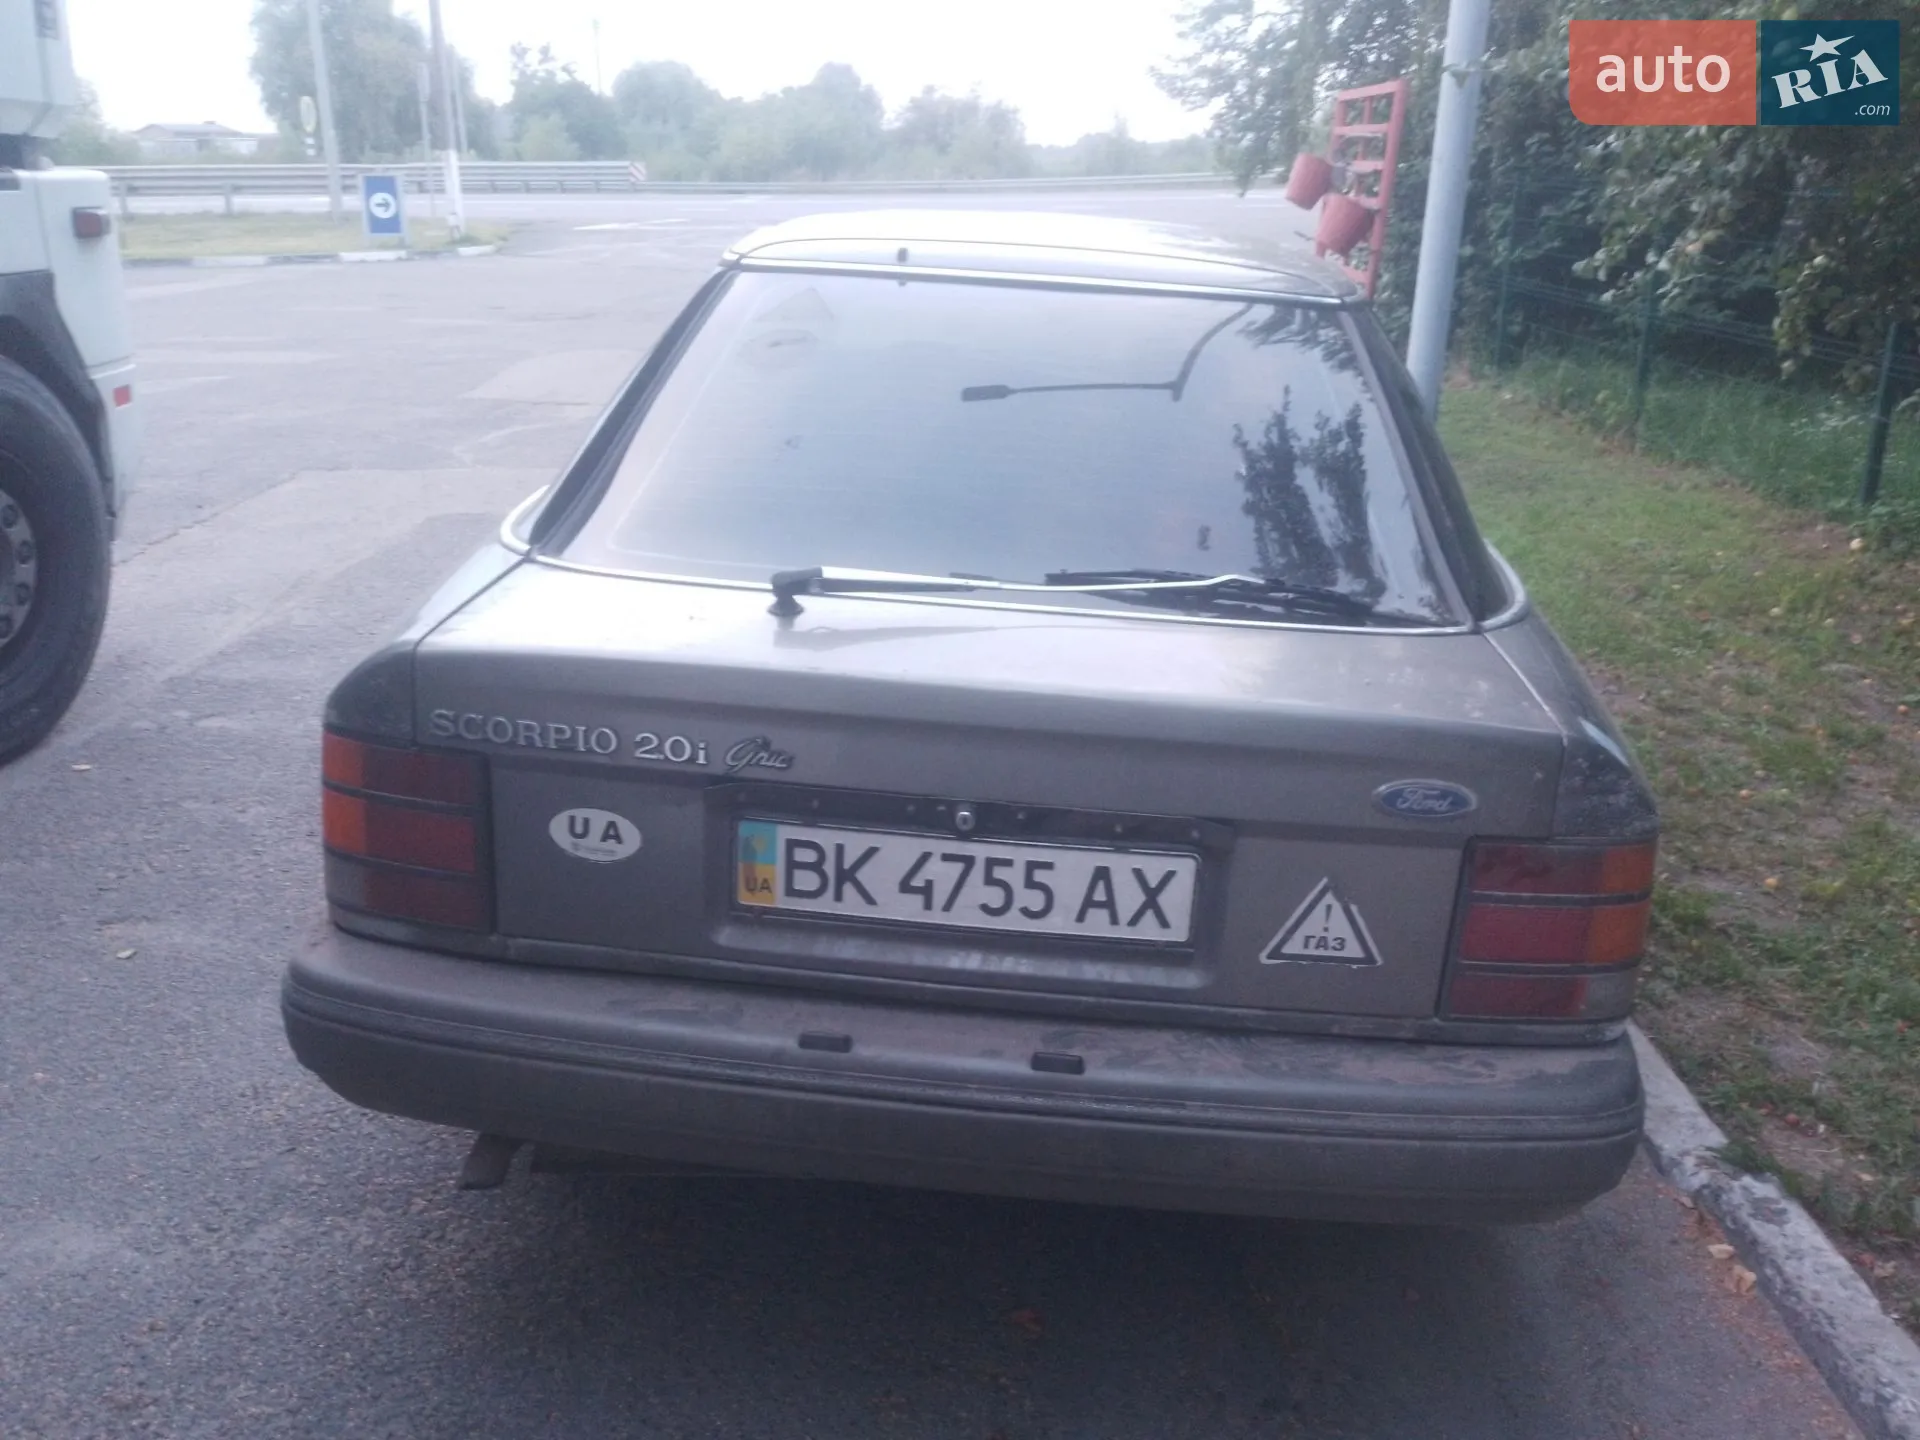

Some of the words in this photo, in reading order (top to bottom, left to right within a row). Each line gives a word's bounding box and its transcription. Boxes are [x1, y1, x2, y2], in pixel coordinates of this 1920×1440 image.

[430, 709, 618, 754] SCORPIO
[1396, 787, 1453, 811] Ford
[745, 876, 773, 894] UA
[784, 838, 881, 906] BK
[899, 851, 1055, 920] 4755
[1075, 864, 1178, 930] AX
[1303, 934, 1347, 951] ГАЗ
